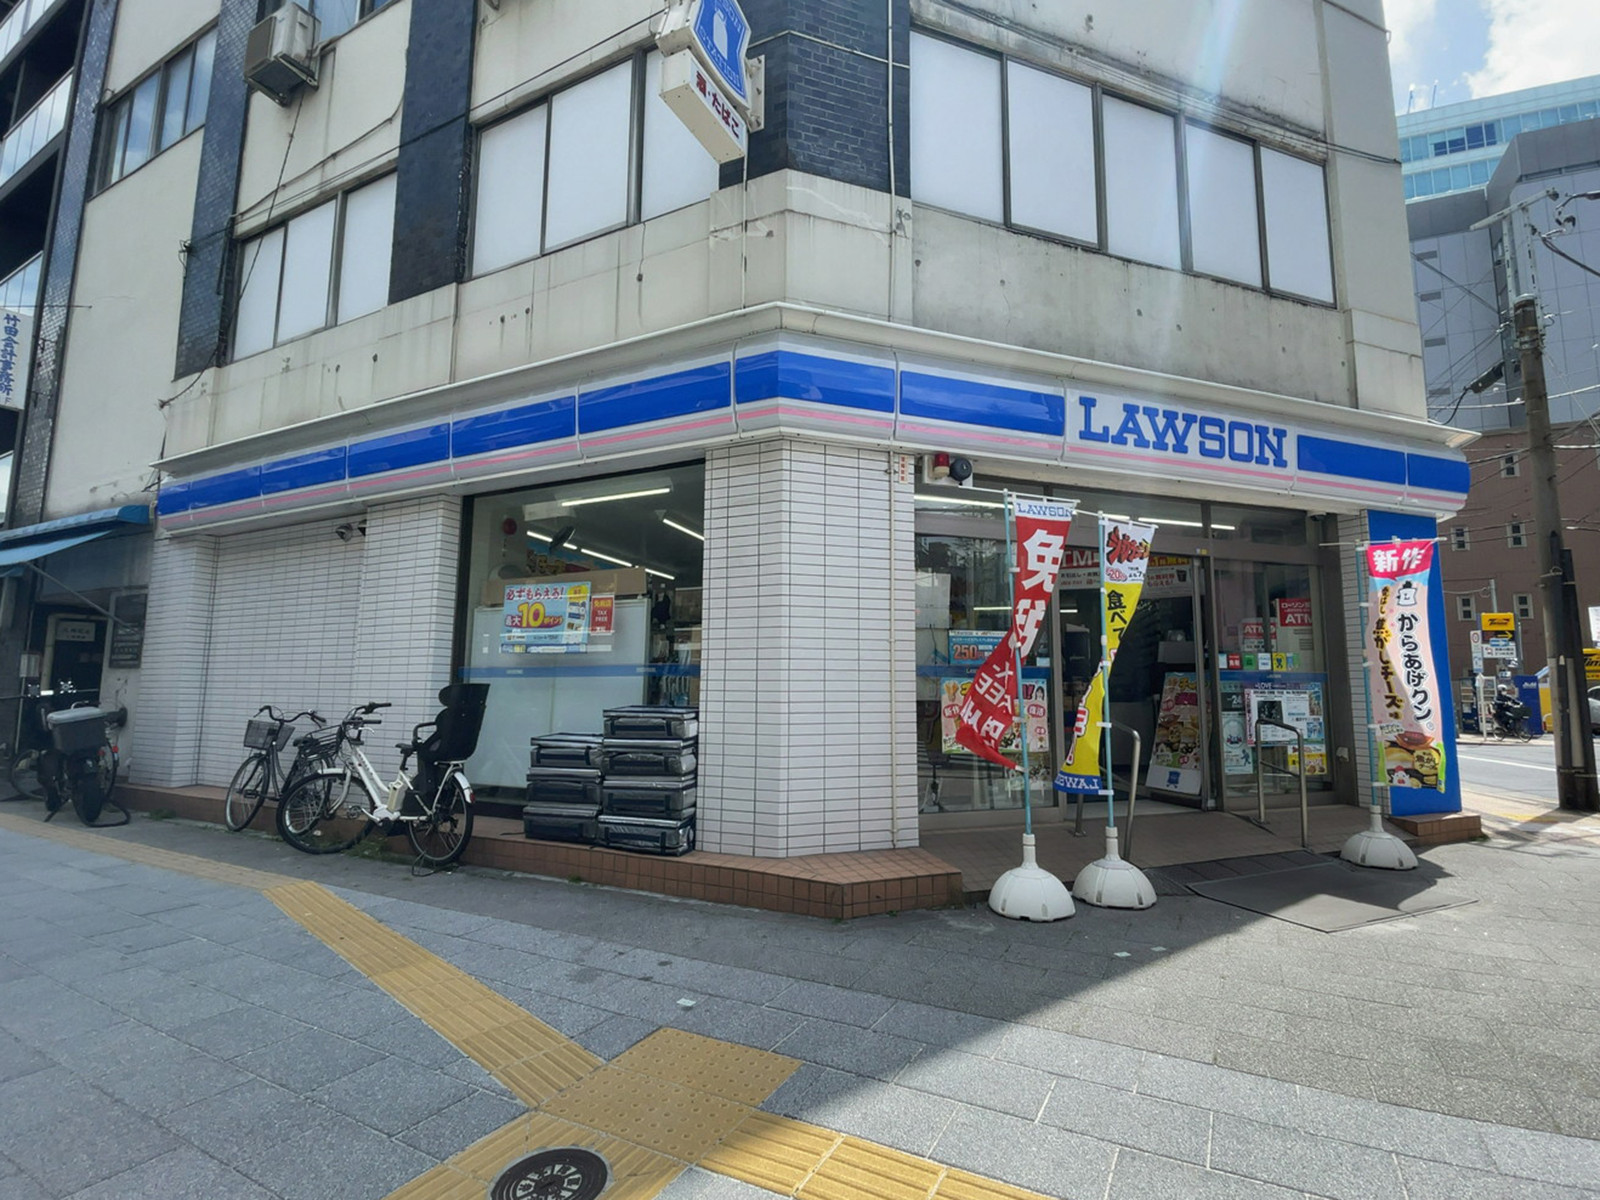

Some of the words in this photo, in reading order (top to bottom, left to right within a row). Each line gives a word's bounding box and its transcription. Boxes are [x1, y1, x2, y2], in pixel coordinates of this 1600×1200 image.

[1079, 396, 1288, 468] LAWSON
[1016, 502, 1073, 517] LAWSON
[1062, 551, 1093, 566] TM
[1373, 547, 1424, 573] 新作
[506, 586, 565, 600] 必ずもらえる!
[1397, 613, 1432, 721] からあげクン
